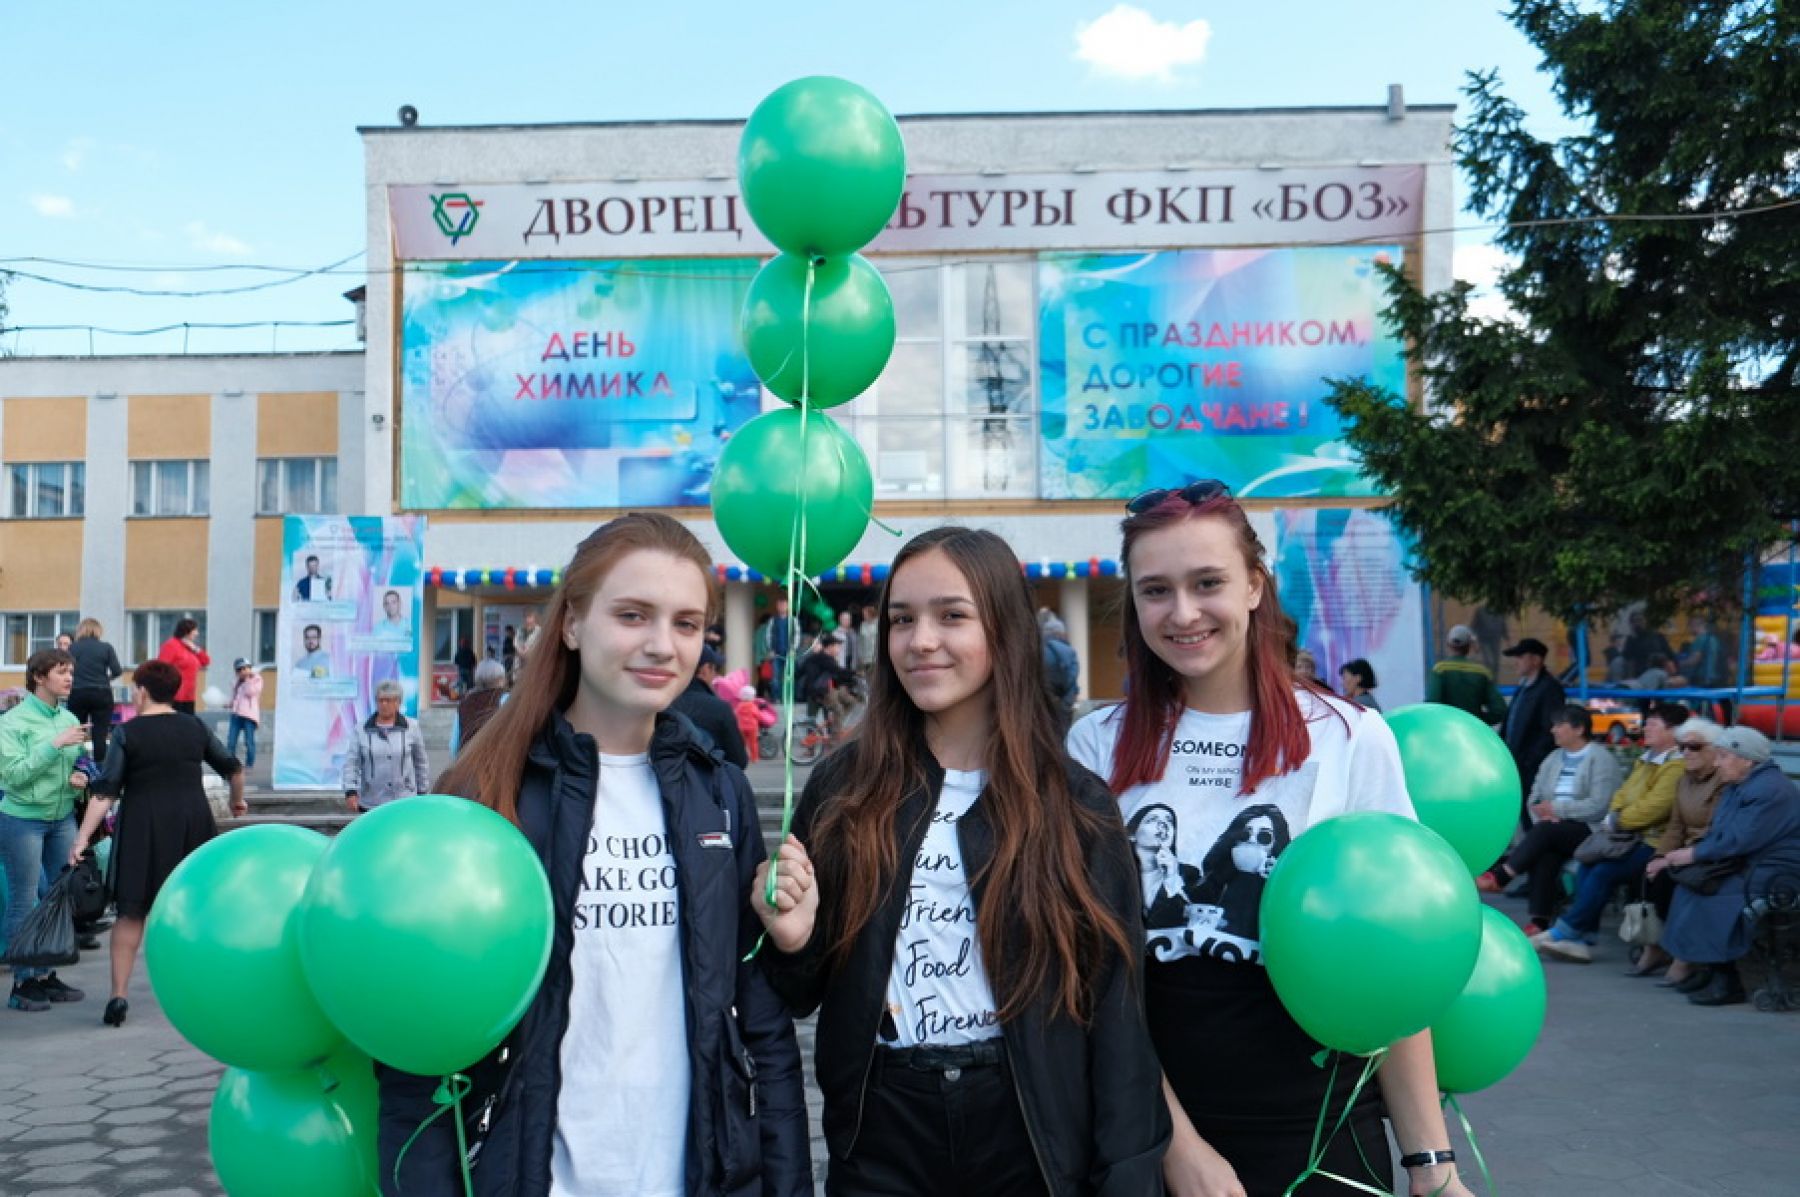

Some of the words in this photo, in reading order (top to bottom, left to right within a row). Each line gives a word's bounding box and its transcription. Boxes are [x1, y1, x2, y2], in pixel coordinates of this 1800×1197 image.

[523, 195, 742, 245] ДВОРЕЦ
[886, 189, 1076, 230] ЬТУРЫ
[1106, 185, 1235, 224] ФКП
[1252, 181, 1409, 221] «БОЗ»
[541, 331, 636, 362] ДЕНЬ
[1083, 324, 1107, 349] С
[1120, 320, 1368, 350] ПРАЗДНИКОМ,
[514, 371, 674, 400] ХИМИКА
[1082, 361, 1244, 392] ДОРОГИЕ
[1188, 777, 1232, 788] MAYBE
[914, 853, 958, 872] un
[574, 902, 677, 930] STORIE
[904, 937, 970, 988] Food
